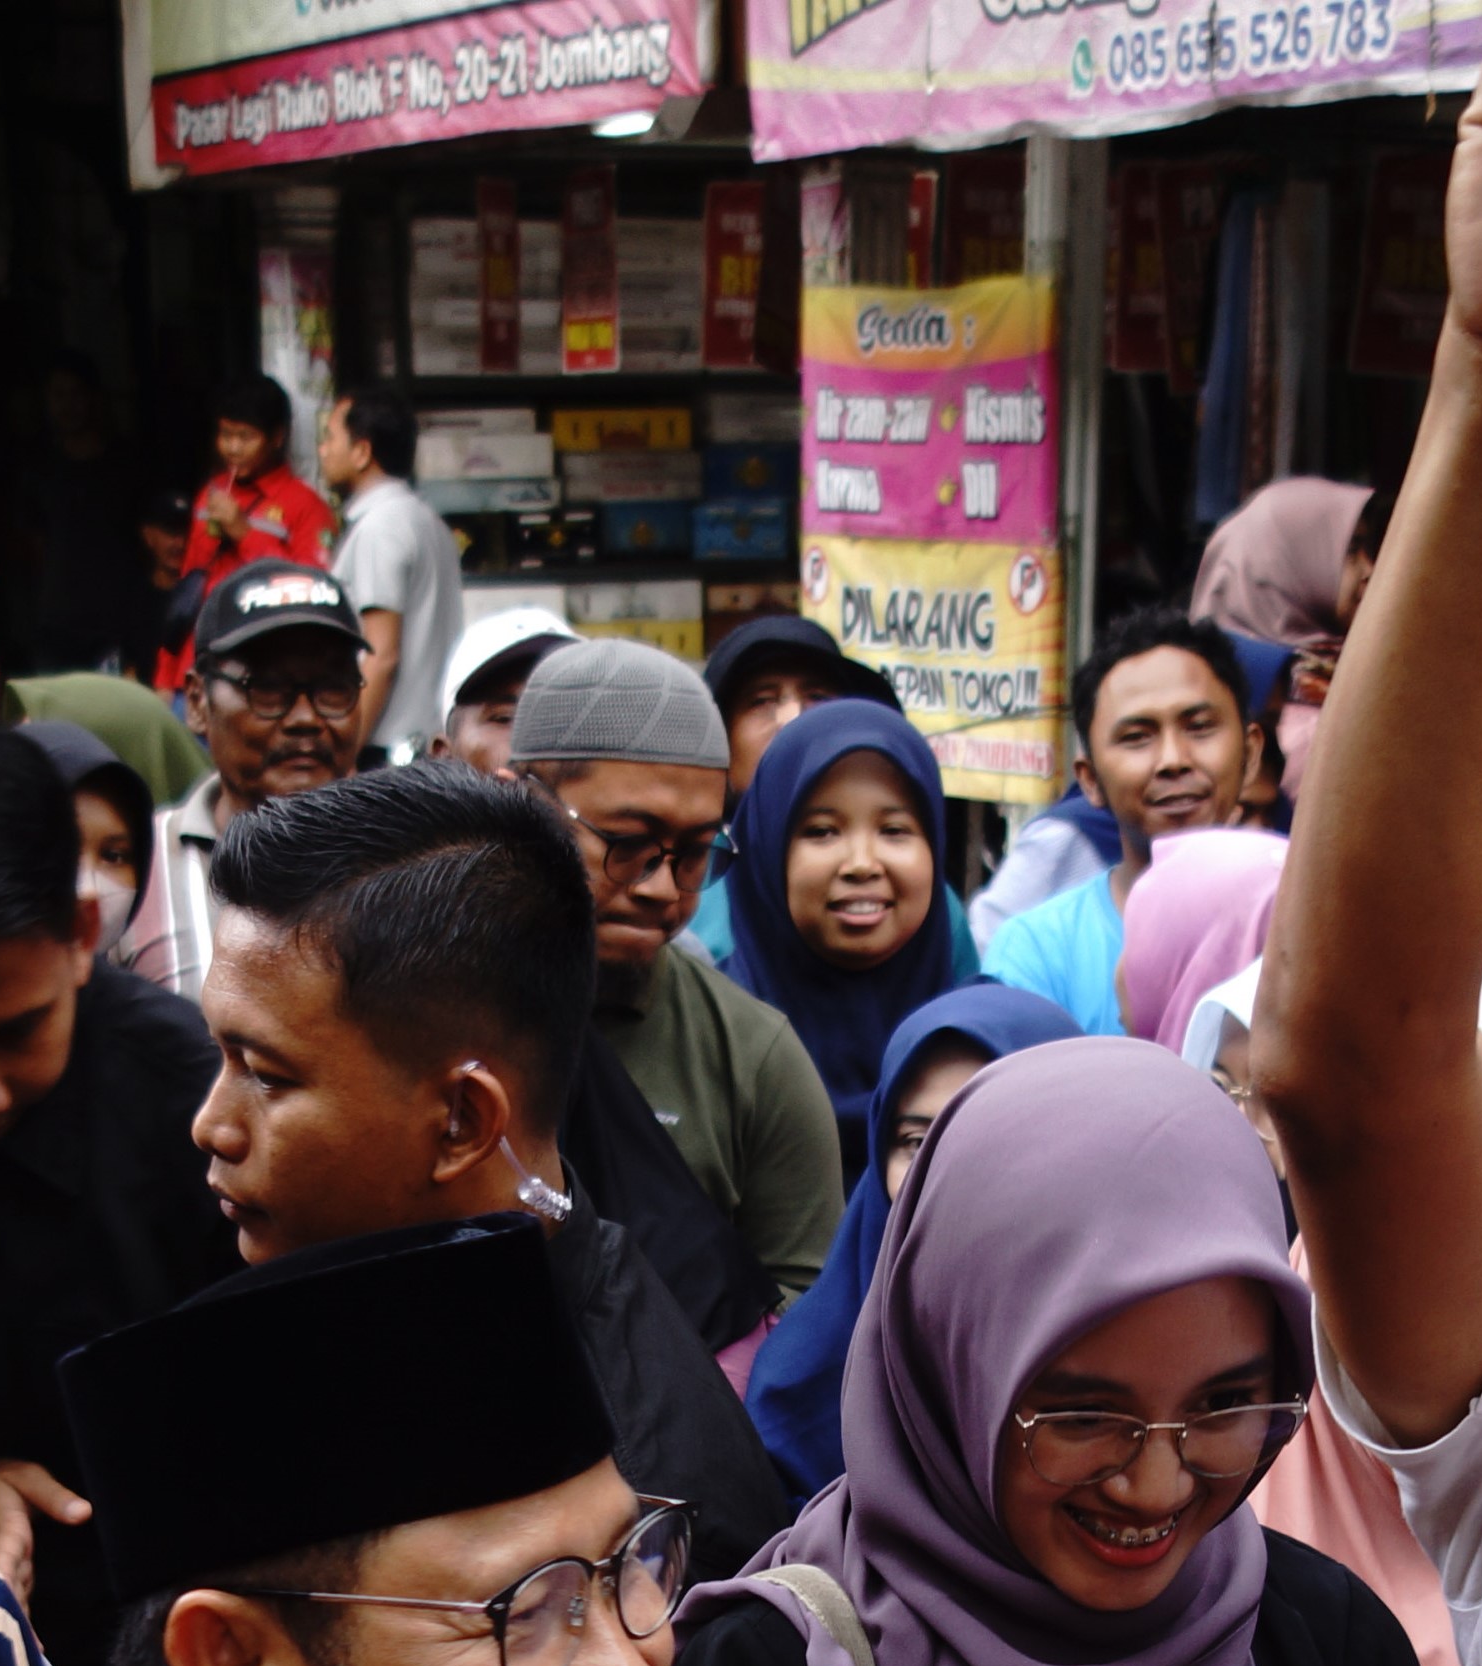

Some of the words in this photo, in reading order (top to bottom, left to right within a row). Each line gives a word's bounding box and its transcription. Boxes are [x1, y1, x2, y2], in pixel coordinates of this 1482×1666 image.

[1109, 28, 1168, 85] 085
[1249, 7, 1313, 68] 526
[1325, 0, 1391, 58] 783
[175, 101, 229, 150] Pasar
[230, 88, 271, 147] Legi
[273, 79, 330, 134] Ruko
[333, 63, 384, 125] Blok
[454, 34, 528, 104] 20-21
[534, 17, 671, 87] Jombang
[857, 303, 950, 353] Sedia
[841, 586, 995, 651] DILARANG
